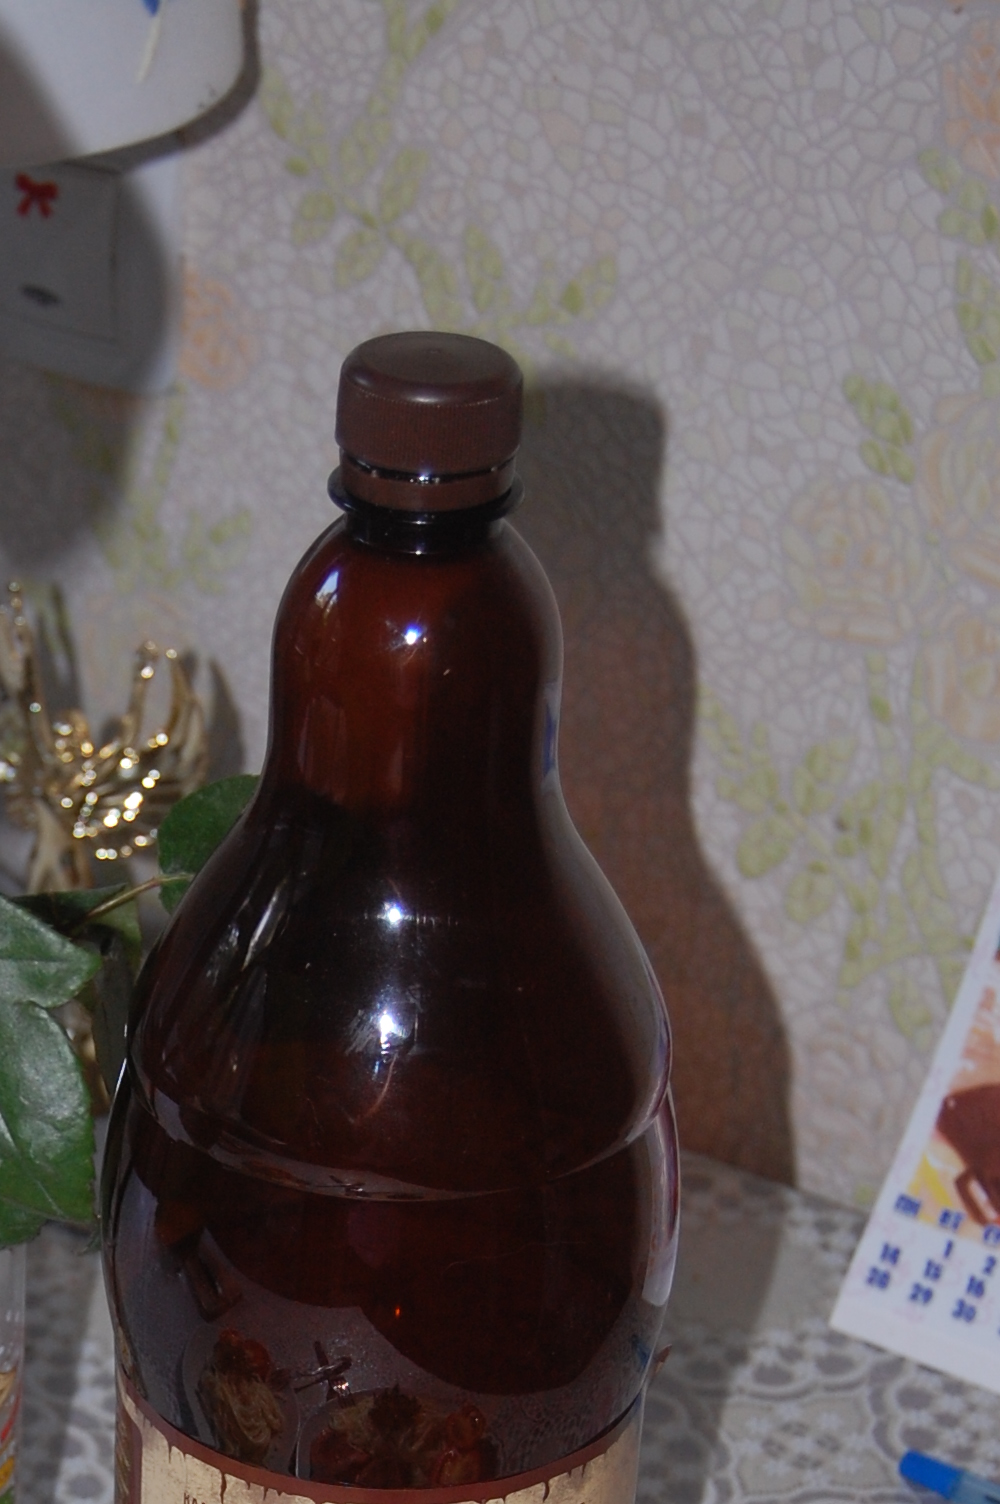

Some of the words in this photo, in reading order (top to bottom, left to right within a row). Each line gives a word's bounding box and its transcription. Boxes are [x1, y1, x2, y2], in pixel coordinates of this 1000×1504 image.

[944, 1240, 953, 1258] 1
[967, 1275, 985, 1298] 16
[910, 1283, 933, 1304] 29
[952, 1299, 976, 1322] 30
